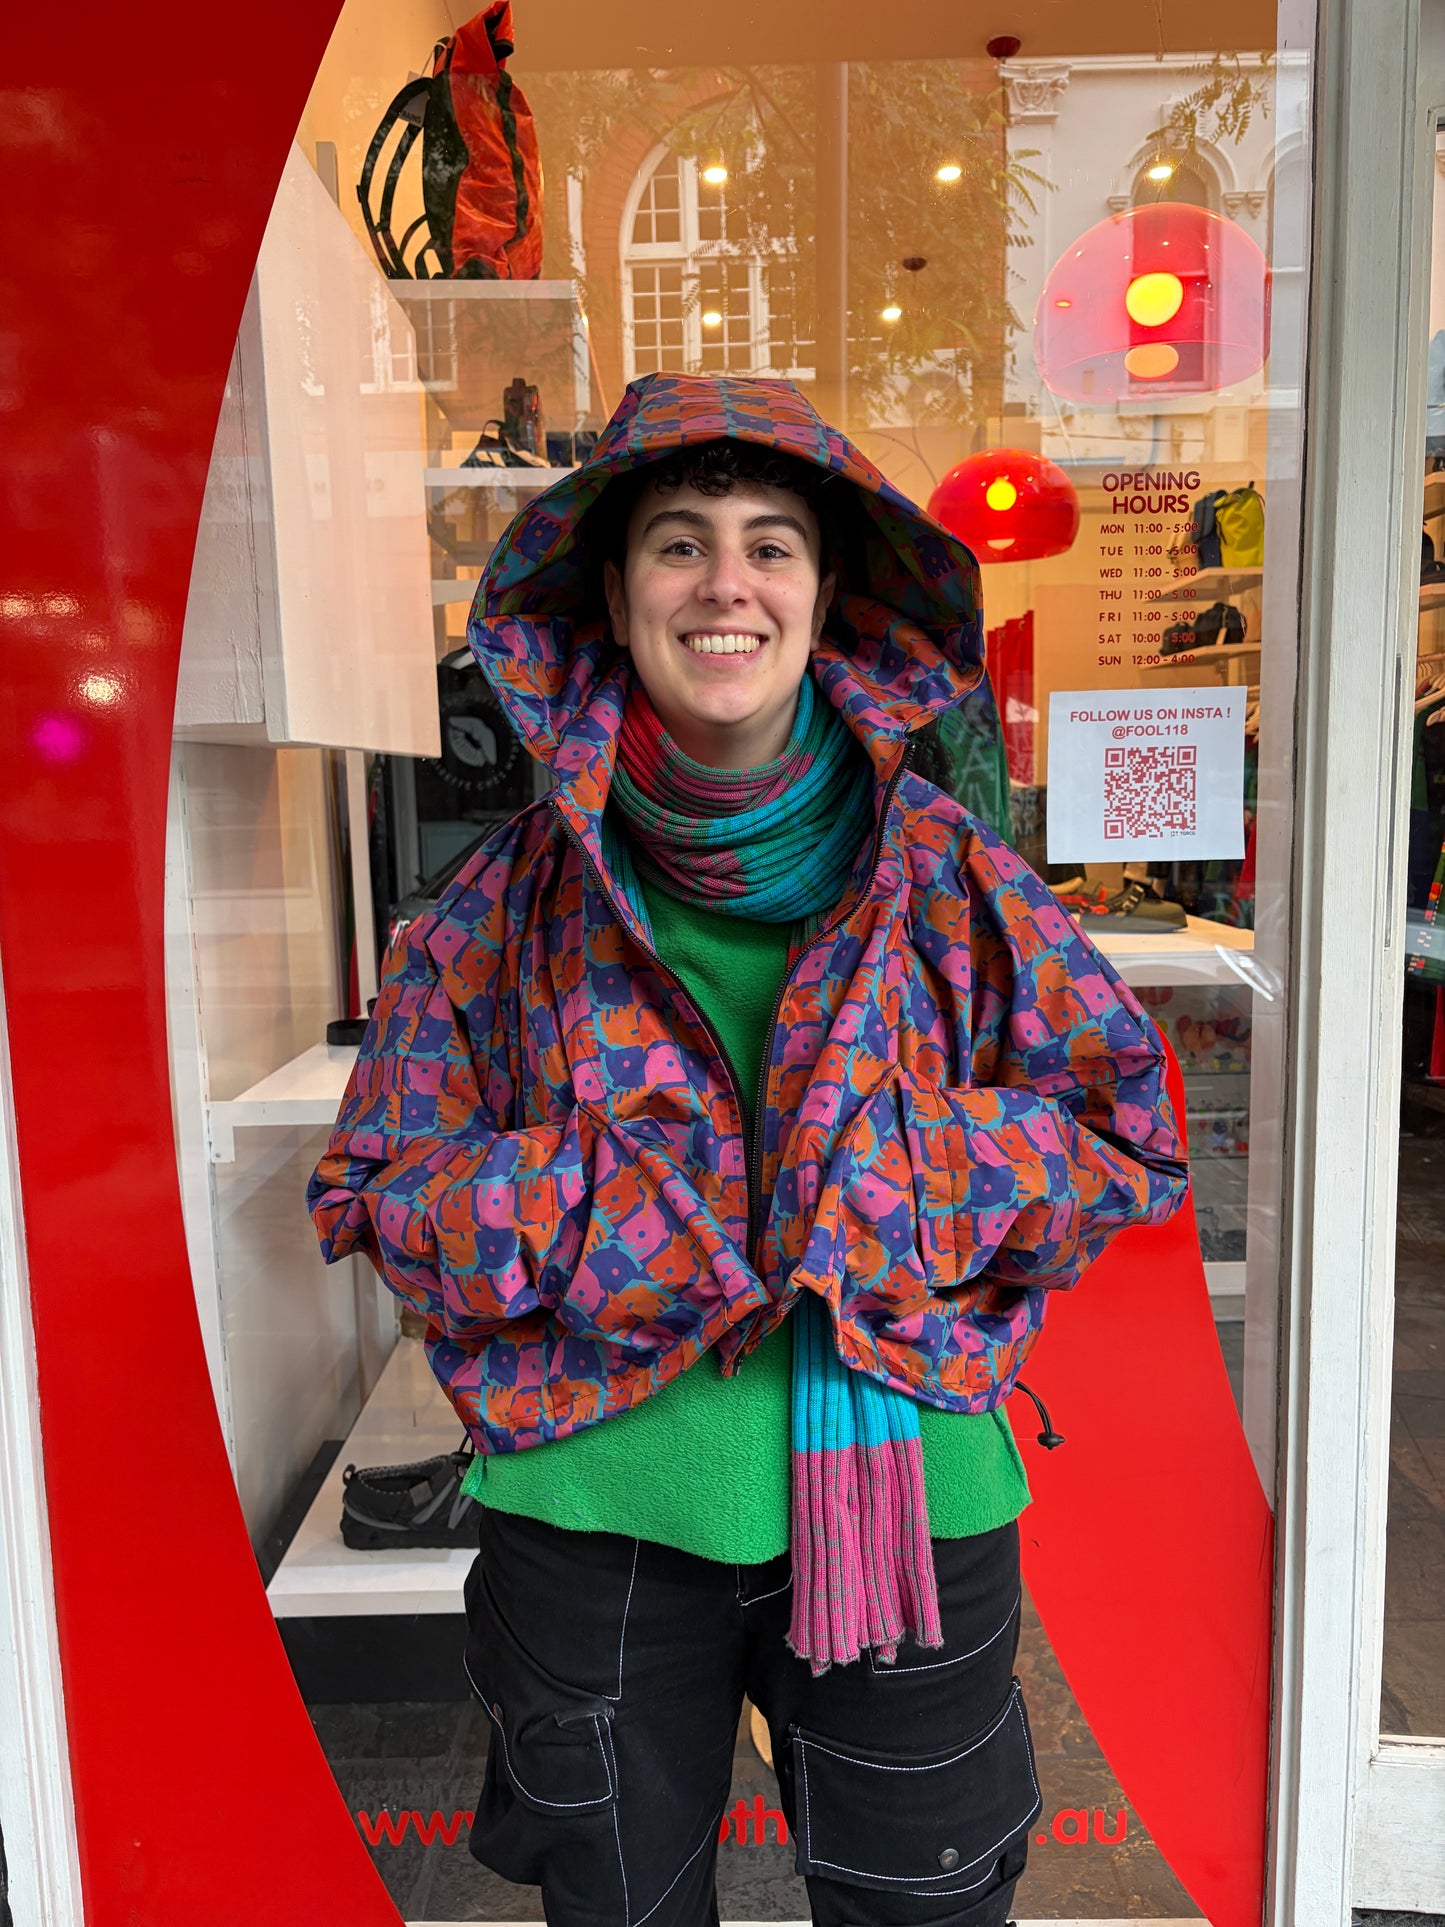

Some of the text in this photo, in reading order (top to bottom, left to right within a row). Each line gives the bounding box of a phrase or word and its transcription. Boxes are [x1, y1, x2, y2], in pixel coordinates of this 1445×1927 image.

[1102, 471, 1200, 492] OPENING
[1113, 494, 1189, 514] HOURS
[1100, 524, 1124, 534] MON
[1134, 523, 1162, 533] 11:00
[1173, 523, 1199, 533] 5:00
[1100, 546, 1123, 556] TUE
[1134, 545, 1162, 555] 11:00
[1173, 545, 1198, 556] 5:00
[1100, 568, 1123, 578] WED
[1133, 567, 1162, 577] 11:00
[1173, 567, 1197, 578] 5:00
[1099, 590, 1122, 600] THU
[1133, 589, 1161, 599] 11:00
[1099, 612, 1121, 622] FRI
[1132, 611, 1161, 621] 11:00
[1171, 611, 1196, 621] 5:00
[1098, 634, 1122, 644] SAT
[1132, 633, 1160, 643] 10:00
[1171, 633, 1196, 643] 5:00
[1098, 656, 1121, 666] SUN
[1132, 655, 1160, 665] 12:00
[1070, 707, 1231, 722] FOLLOW US ON INSTA !
[1112, 724, 1188, 739] @FOOL118
[358, 1810, 475, 1846] ww
